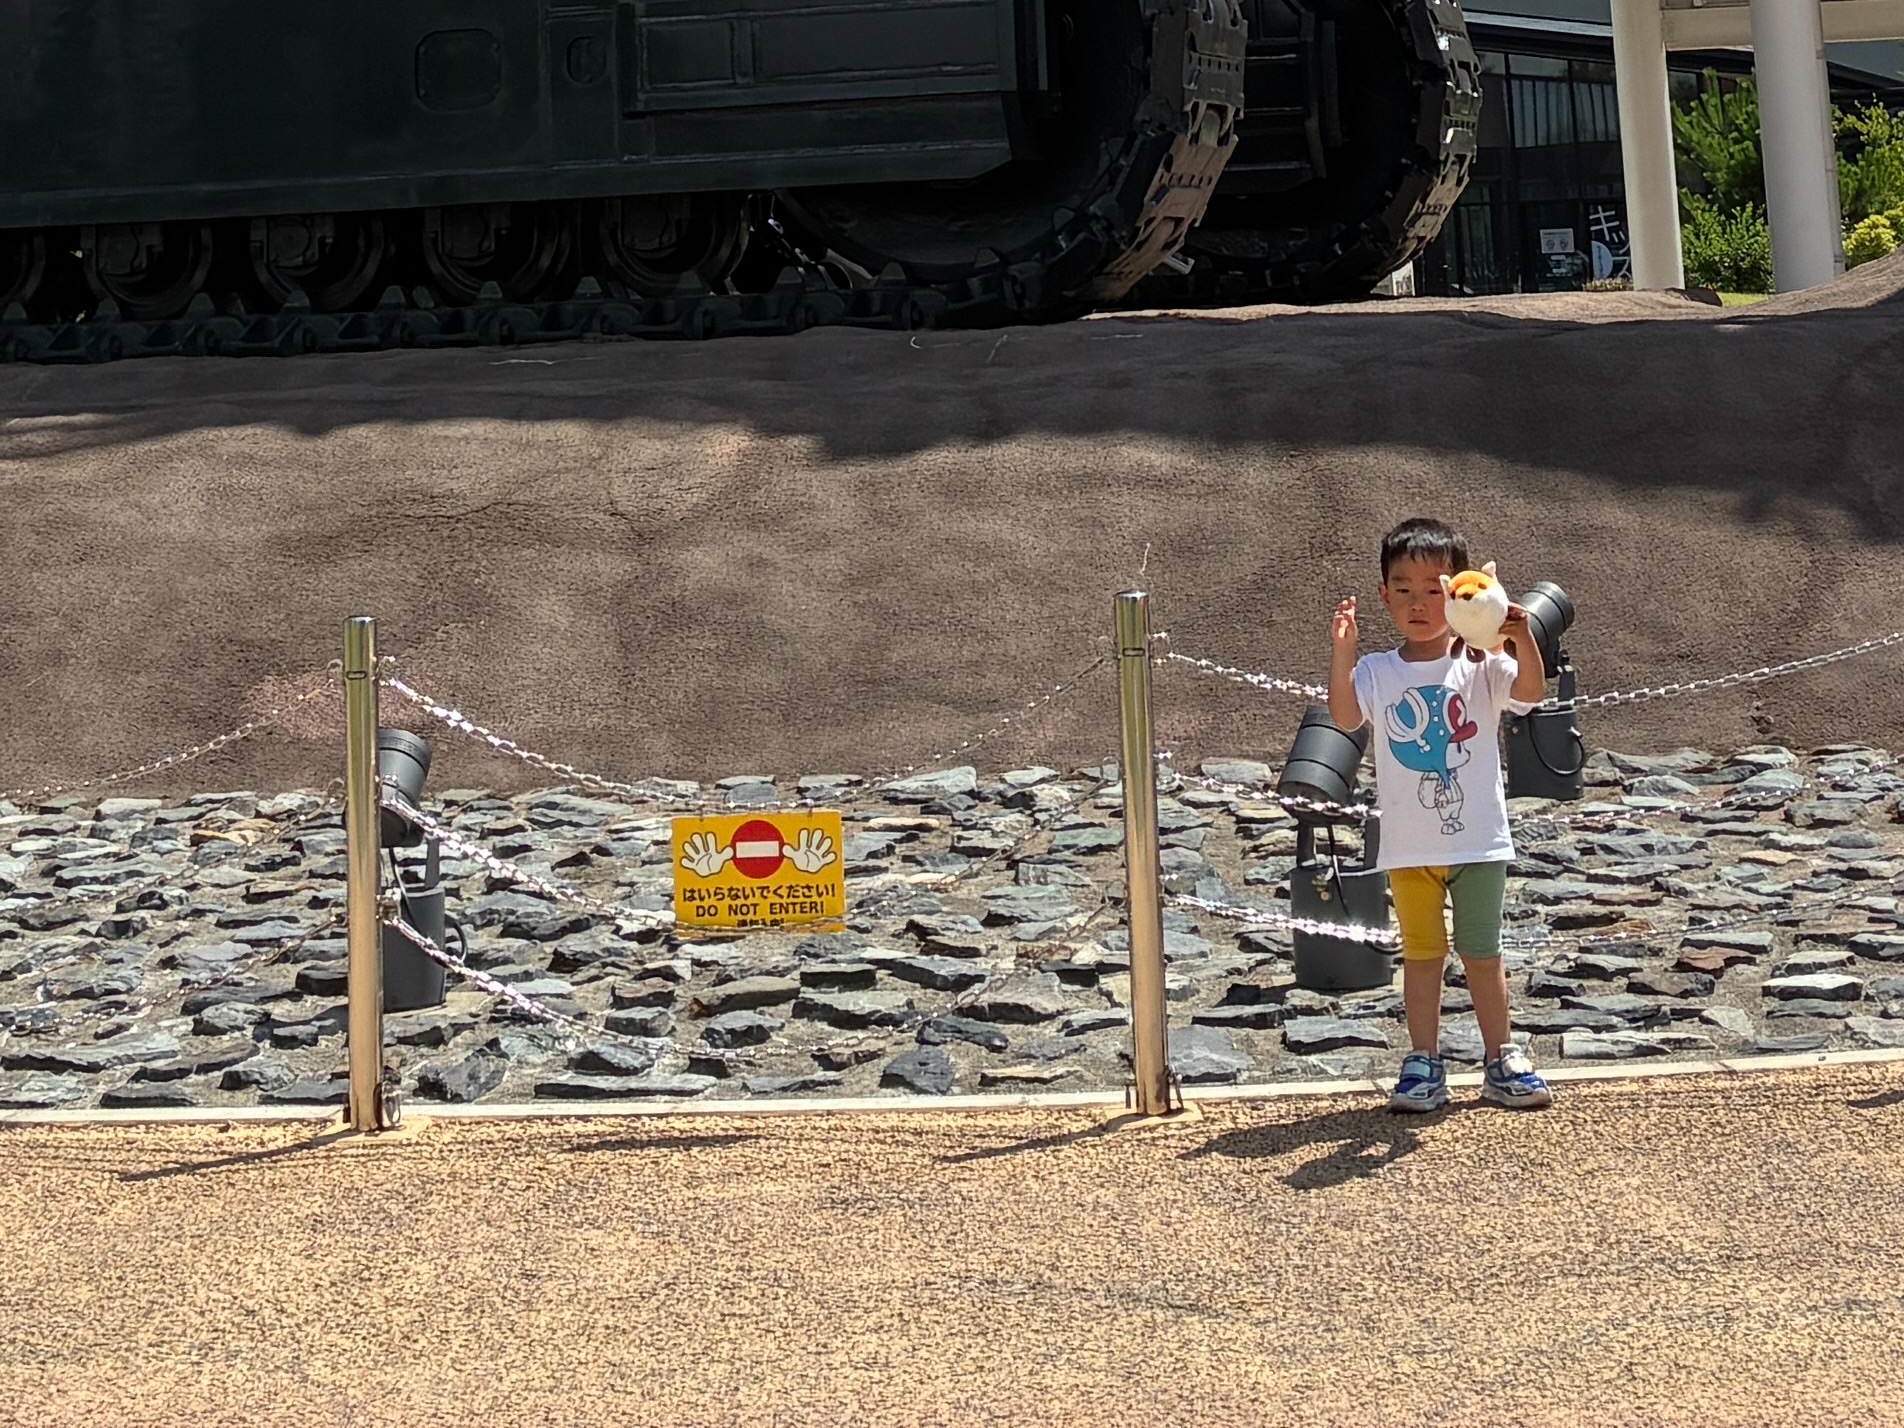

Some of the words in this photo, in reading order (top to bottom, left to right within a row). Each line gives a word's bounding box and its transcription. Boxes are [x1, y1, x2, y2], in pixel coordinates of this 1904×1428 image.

[682, 883, 835, 902] はいらないでください!
[696, 904, 719, 917] DO
[728, 903, 760, 917] NOT
[769, 901, 824, 915] ENTER!
